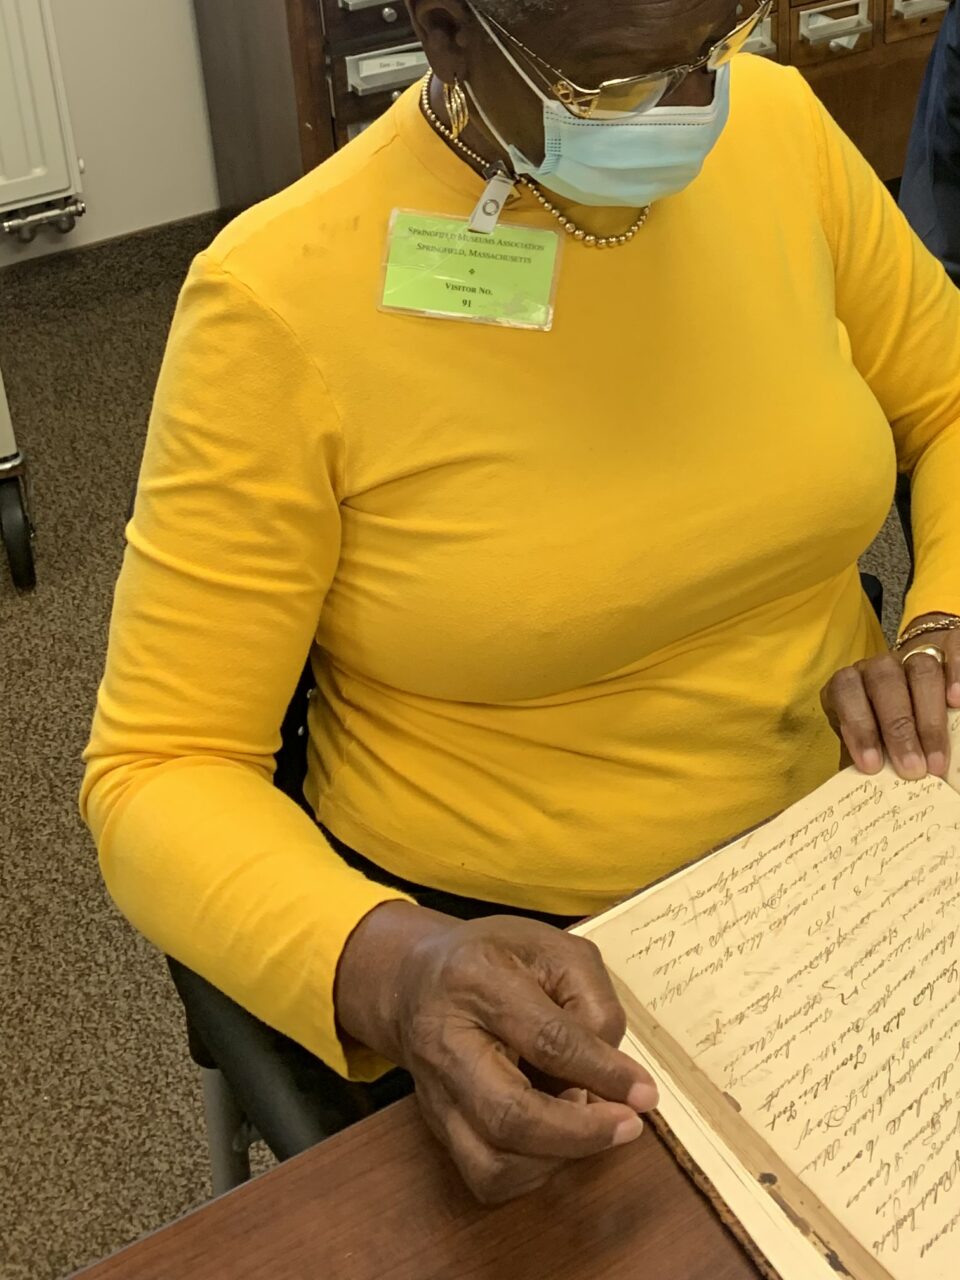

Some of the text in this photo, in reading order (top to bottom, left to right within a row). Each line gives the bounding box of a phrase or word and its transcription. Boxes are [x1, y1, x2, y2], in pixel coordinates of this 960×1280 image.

[498, 239, 545, 251] ASSOCIATION
[469, 250, 532, 264] MASSACHUSETTS
[445, 282, 477, 294] VISITOR
[462, 299, 472, 308] 91
